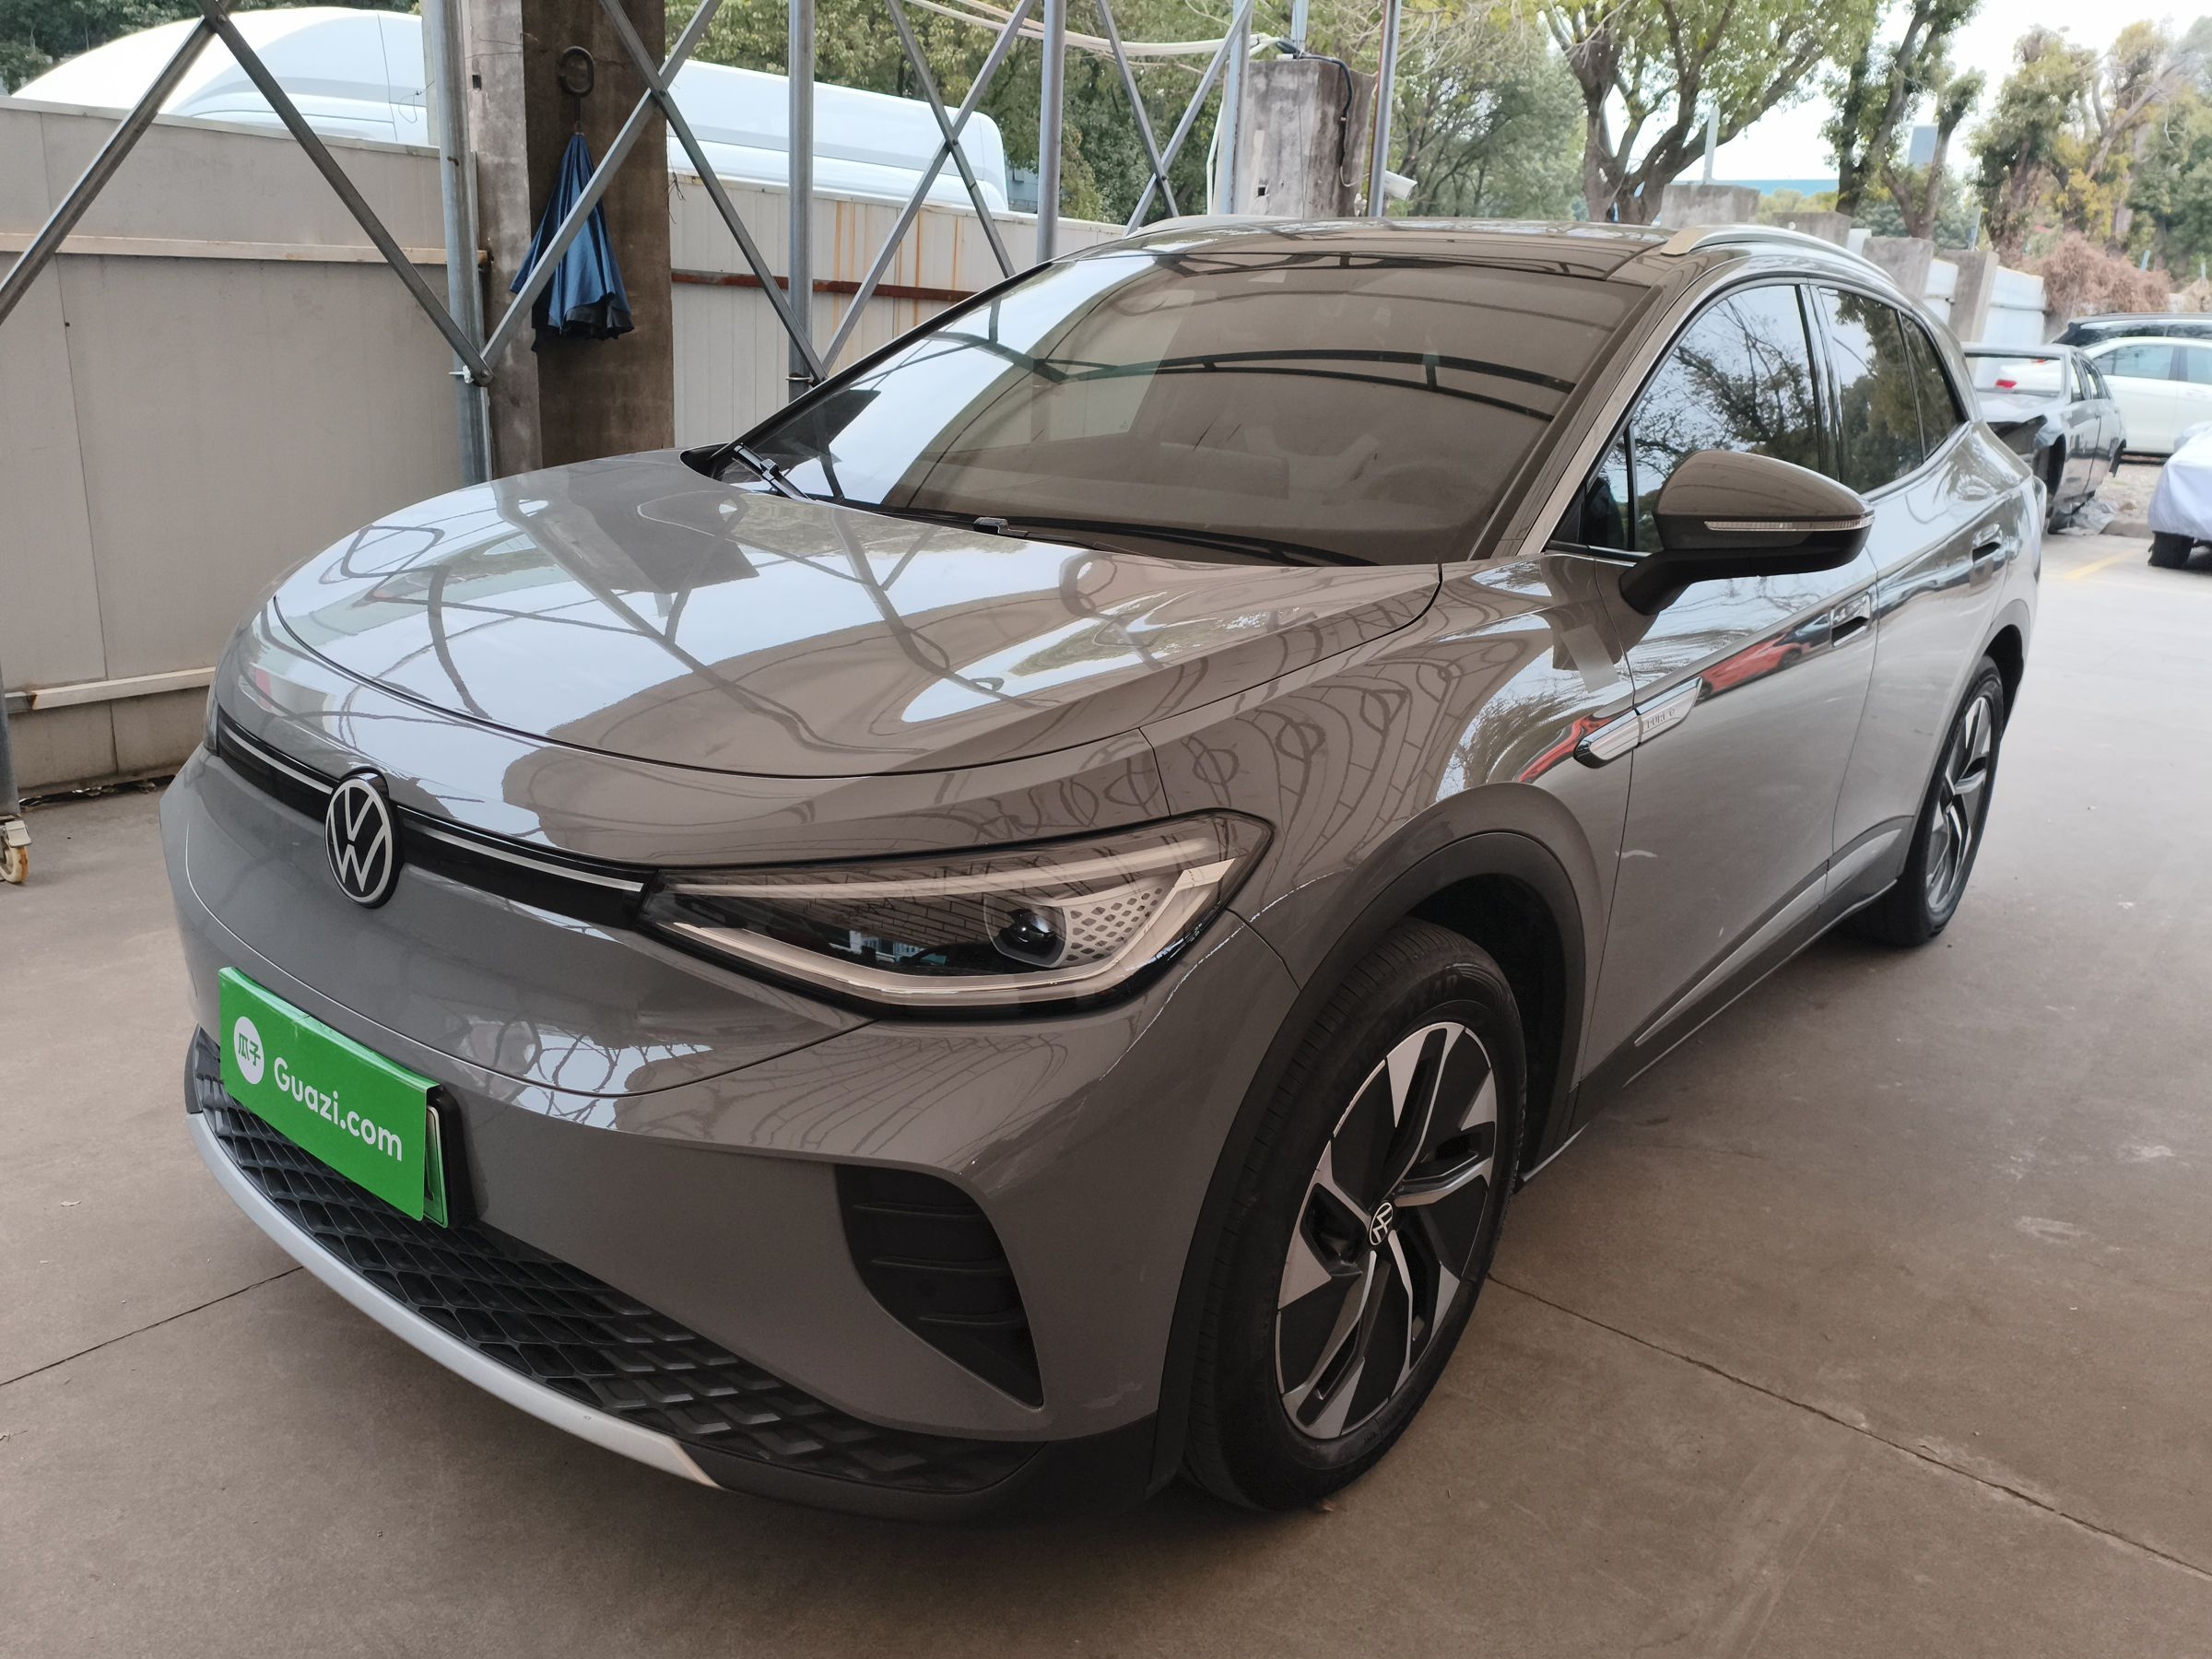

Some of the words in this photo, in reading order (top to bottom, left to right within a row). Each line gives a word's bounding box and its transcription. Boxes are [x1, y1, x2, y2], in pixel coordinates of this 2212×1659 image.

[328, 782, 390, 898] VW
[238, 1032, 261, 1066] 瓜子
[274, 1056, 402, 1161] Guazi.com
